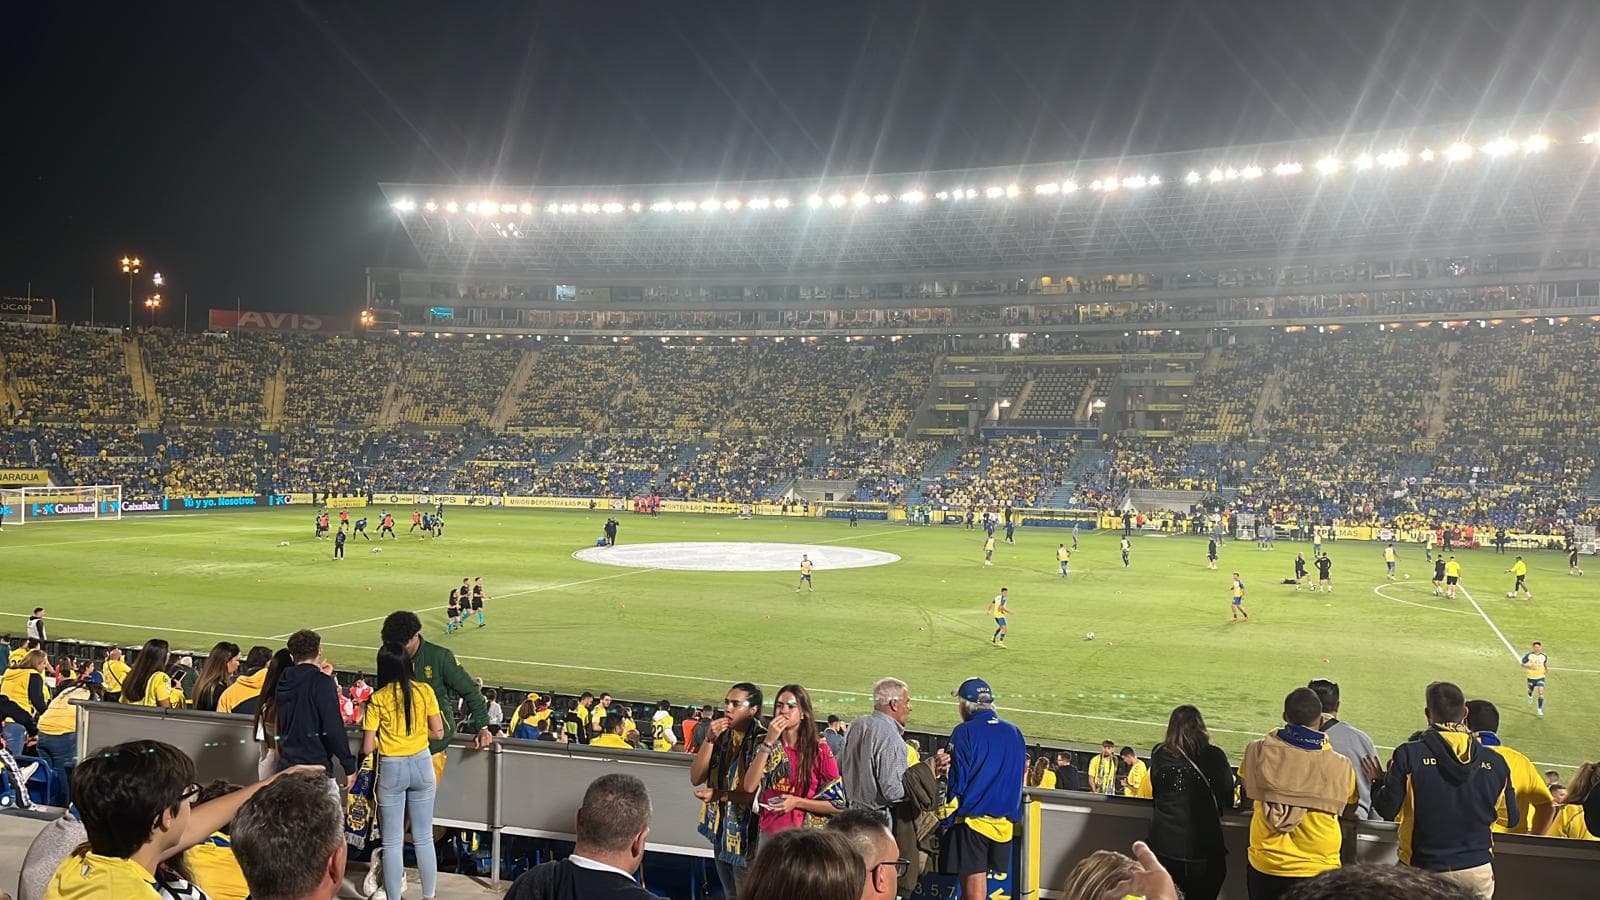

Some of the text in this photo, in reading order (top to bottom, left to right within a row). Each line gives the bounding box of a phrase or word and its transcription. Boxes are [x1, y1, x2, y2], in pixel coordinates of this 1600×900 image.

[239, 311, 322, 330] AVIS
[121, 501, 160, 511] CaixaBank
[218, 496, 256, 506] Nosotros.
[651, 724, 664, 740] 22
